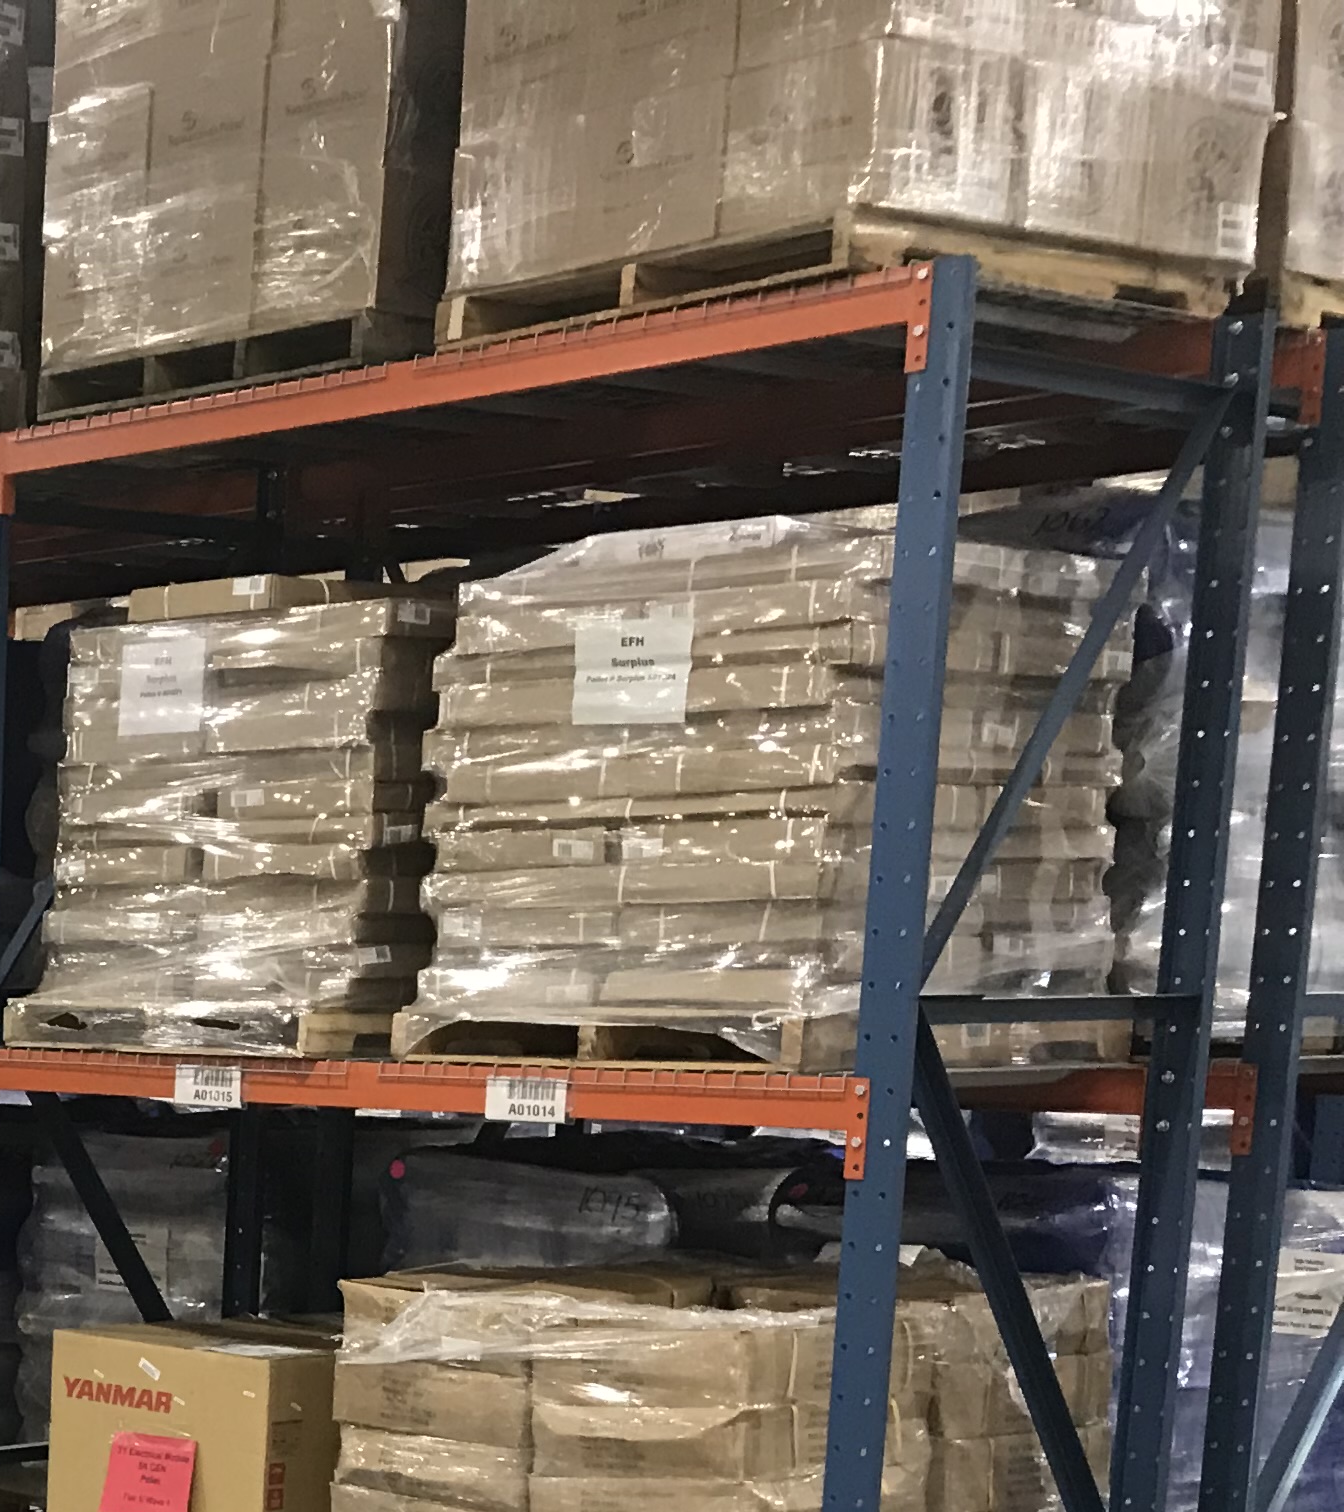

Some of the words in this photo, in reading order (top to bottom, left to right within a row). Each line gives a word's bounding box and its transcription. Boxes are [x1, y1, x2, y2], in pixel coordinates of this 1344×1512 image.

[621, 636, 645, 648] EFH
[611, 656, 656, 670] Surplus
[193, 1088, 233, 1103] A01015
[508, 1102, 556, 1118] A01014
[63, 1374, 173, 1415] YANMAR
